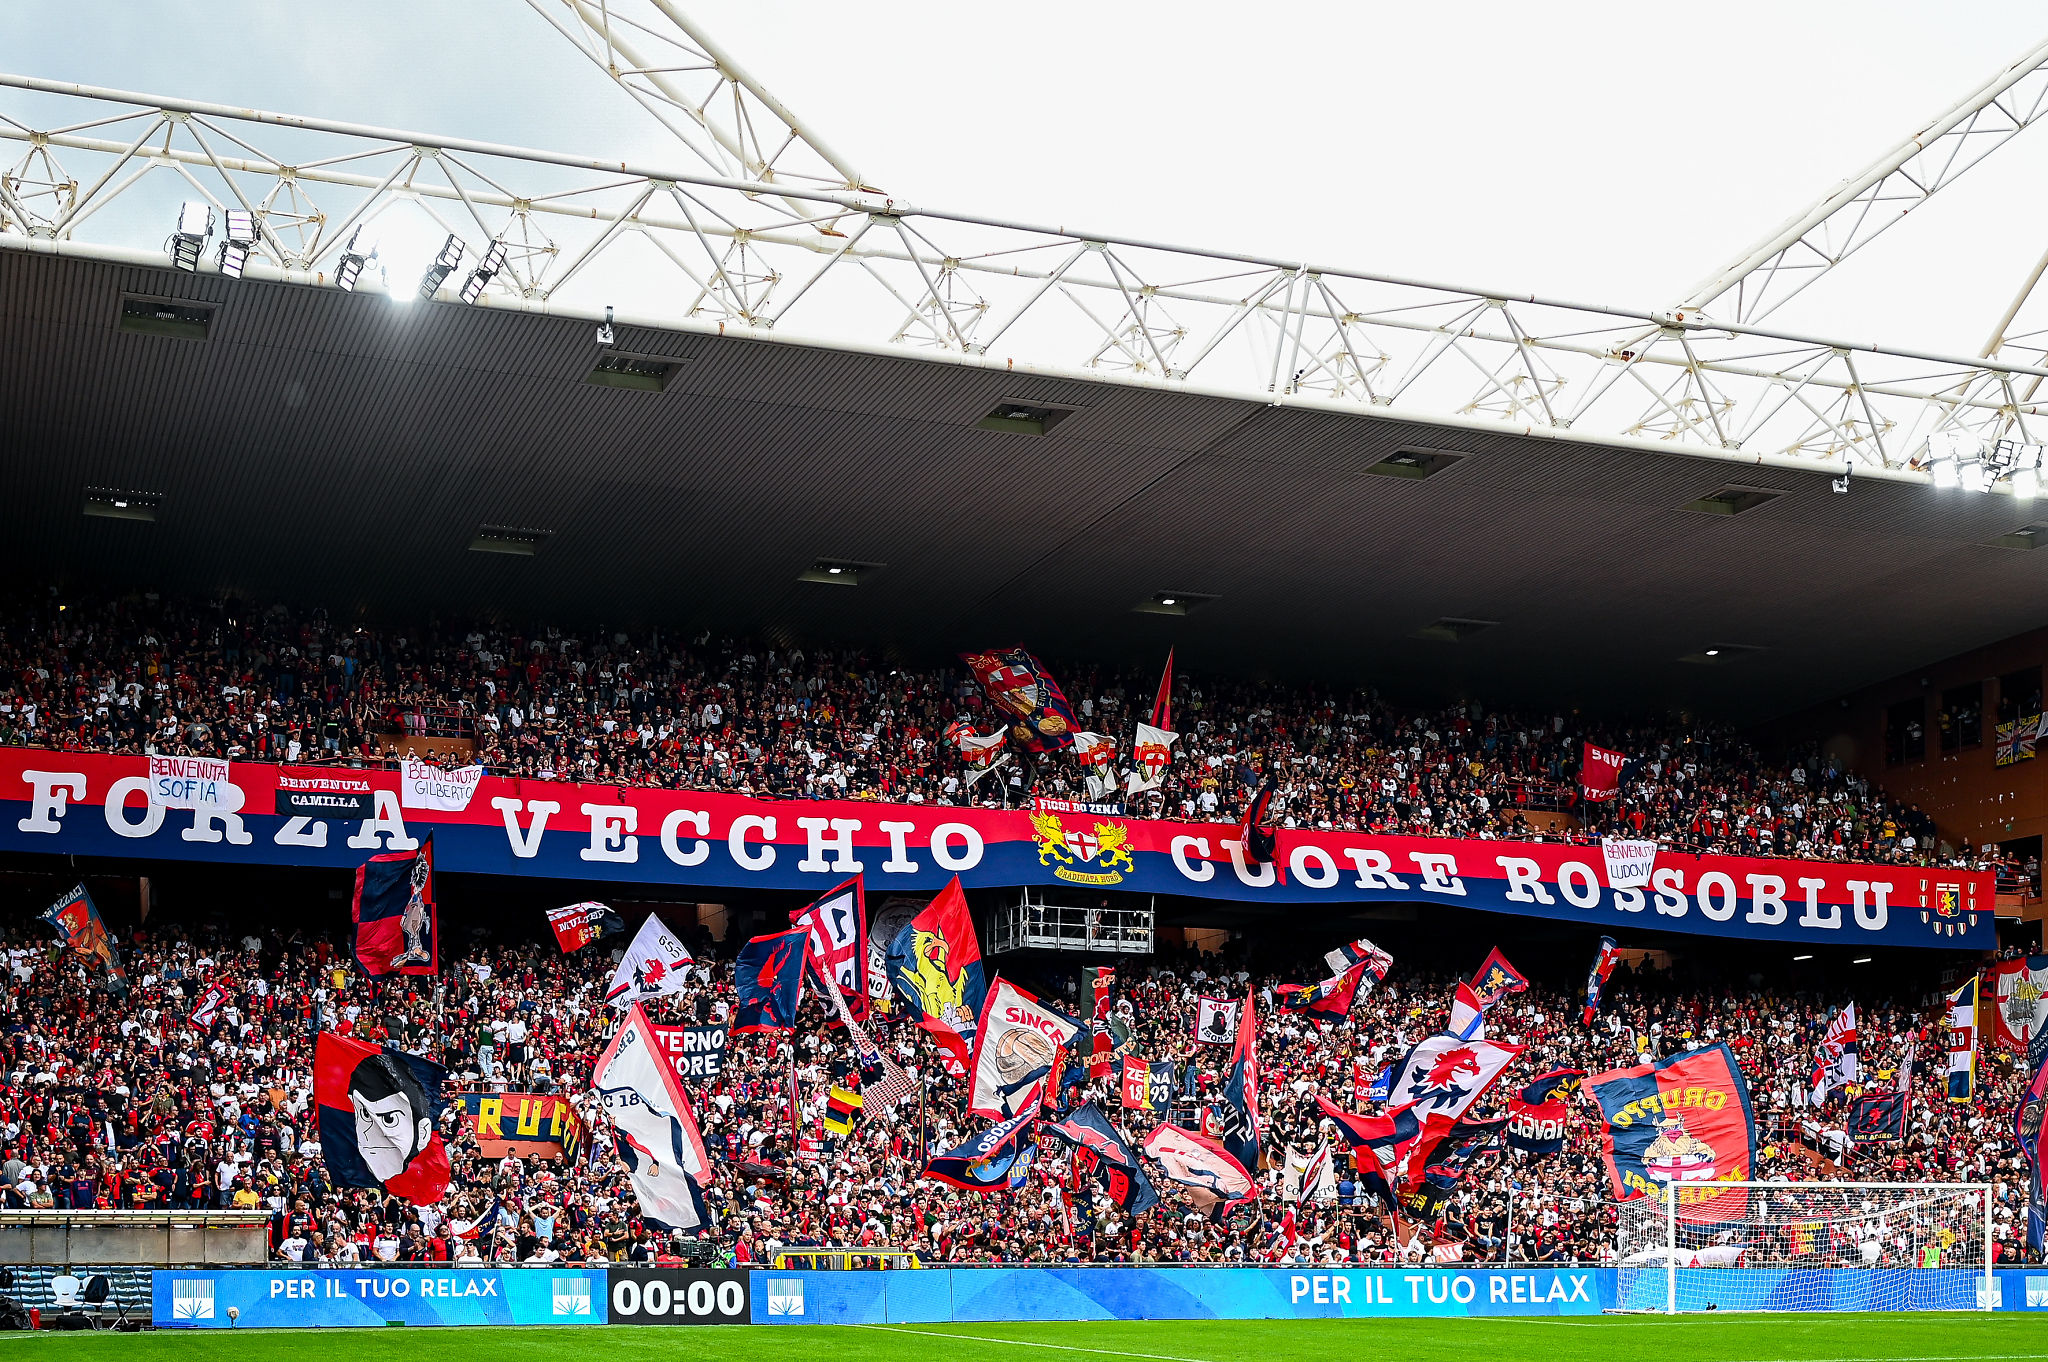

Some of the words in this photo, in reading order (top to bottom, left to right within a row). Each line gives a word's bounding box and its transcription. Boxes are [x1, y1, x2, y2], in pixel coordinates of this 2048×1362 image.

[152, 756, 227, 781] BENVENUTA
[158, 778, 217, 802] SOFIA
[279, 776, 370, 791] BENVENUTA
[414, 781, 473, 800] GILBERTO
[291, 795, 360, 808] CAMILLA
[1089, 804, 1120, 815] ZENA
[490, 796, 985, 874] VECCHIO
[1170, 835, 1467, 897] CUORE
[1208, 1003, 1230, 1013] VIA
[1006, 1006, 1065, 1046] SINCE
[1200, 1026, 1233, 1043] ISONZO
[270, 1278, 316, 1299] PER
[326, 1279, 348, 1298] IL
[356, 1278, 411, 1299] TUO
[420, 1277, 498, 1298] RELAX
[612, 1279, 745, 1316] 00:00
[1290, 1275, 1352, 1304] PER
[1366, 1275, 1393, 1304] IL
[1404, 1275, 1476, 1304] TUO
[1489, 1274, 1590, 1303] RELAX
